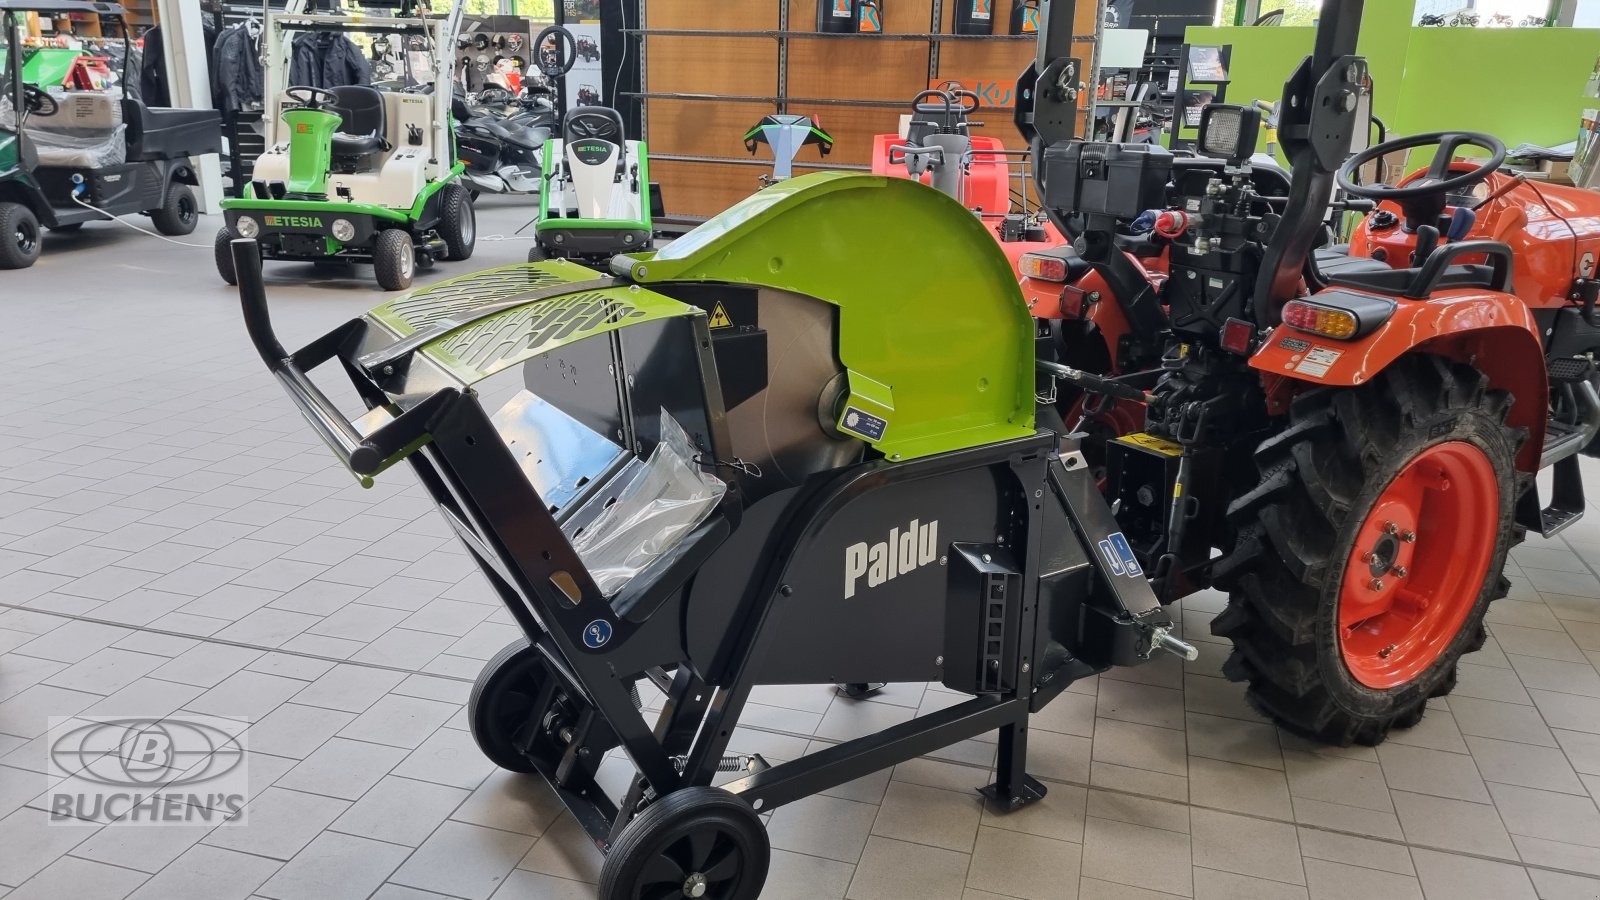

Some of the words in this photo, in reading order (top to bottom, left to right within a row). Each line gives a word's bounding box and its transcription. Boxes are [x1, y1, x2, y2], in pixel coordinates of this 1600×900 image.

[577, 145, 608, 153] ETESIA
[264, 215, 323, 228] ETESIA
[844, 518, 939, 600] Paldu
